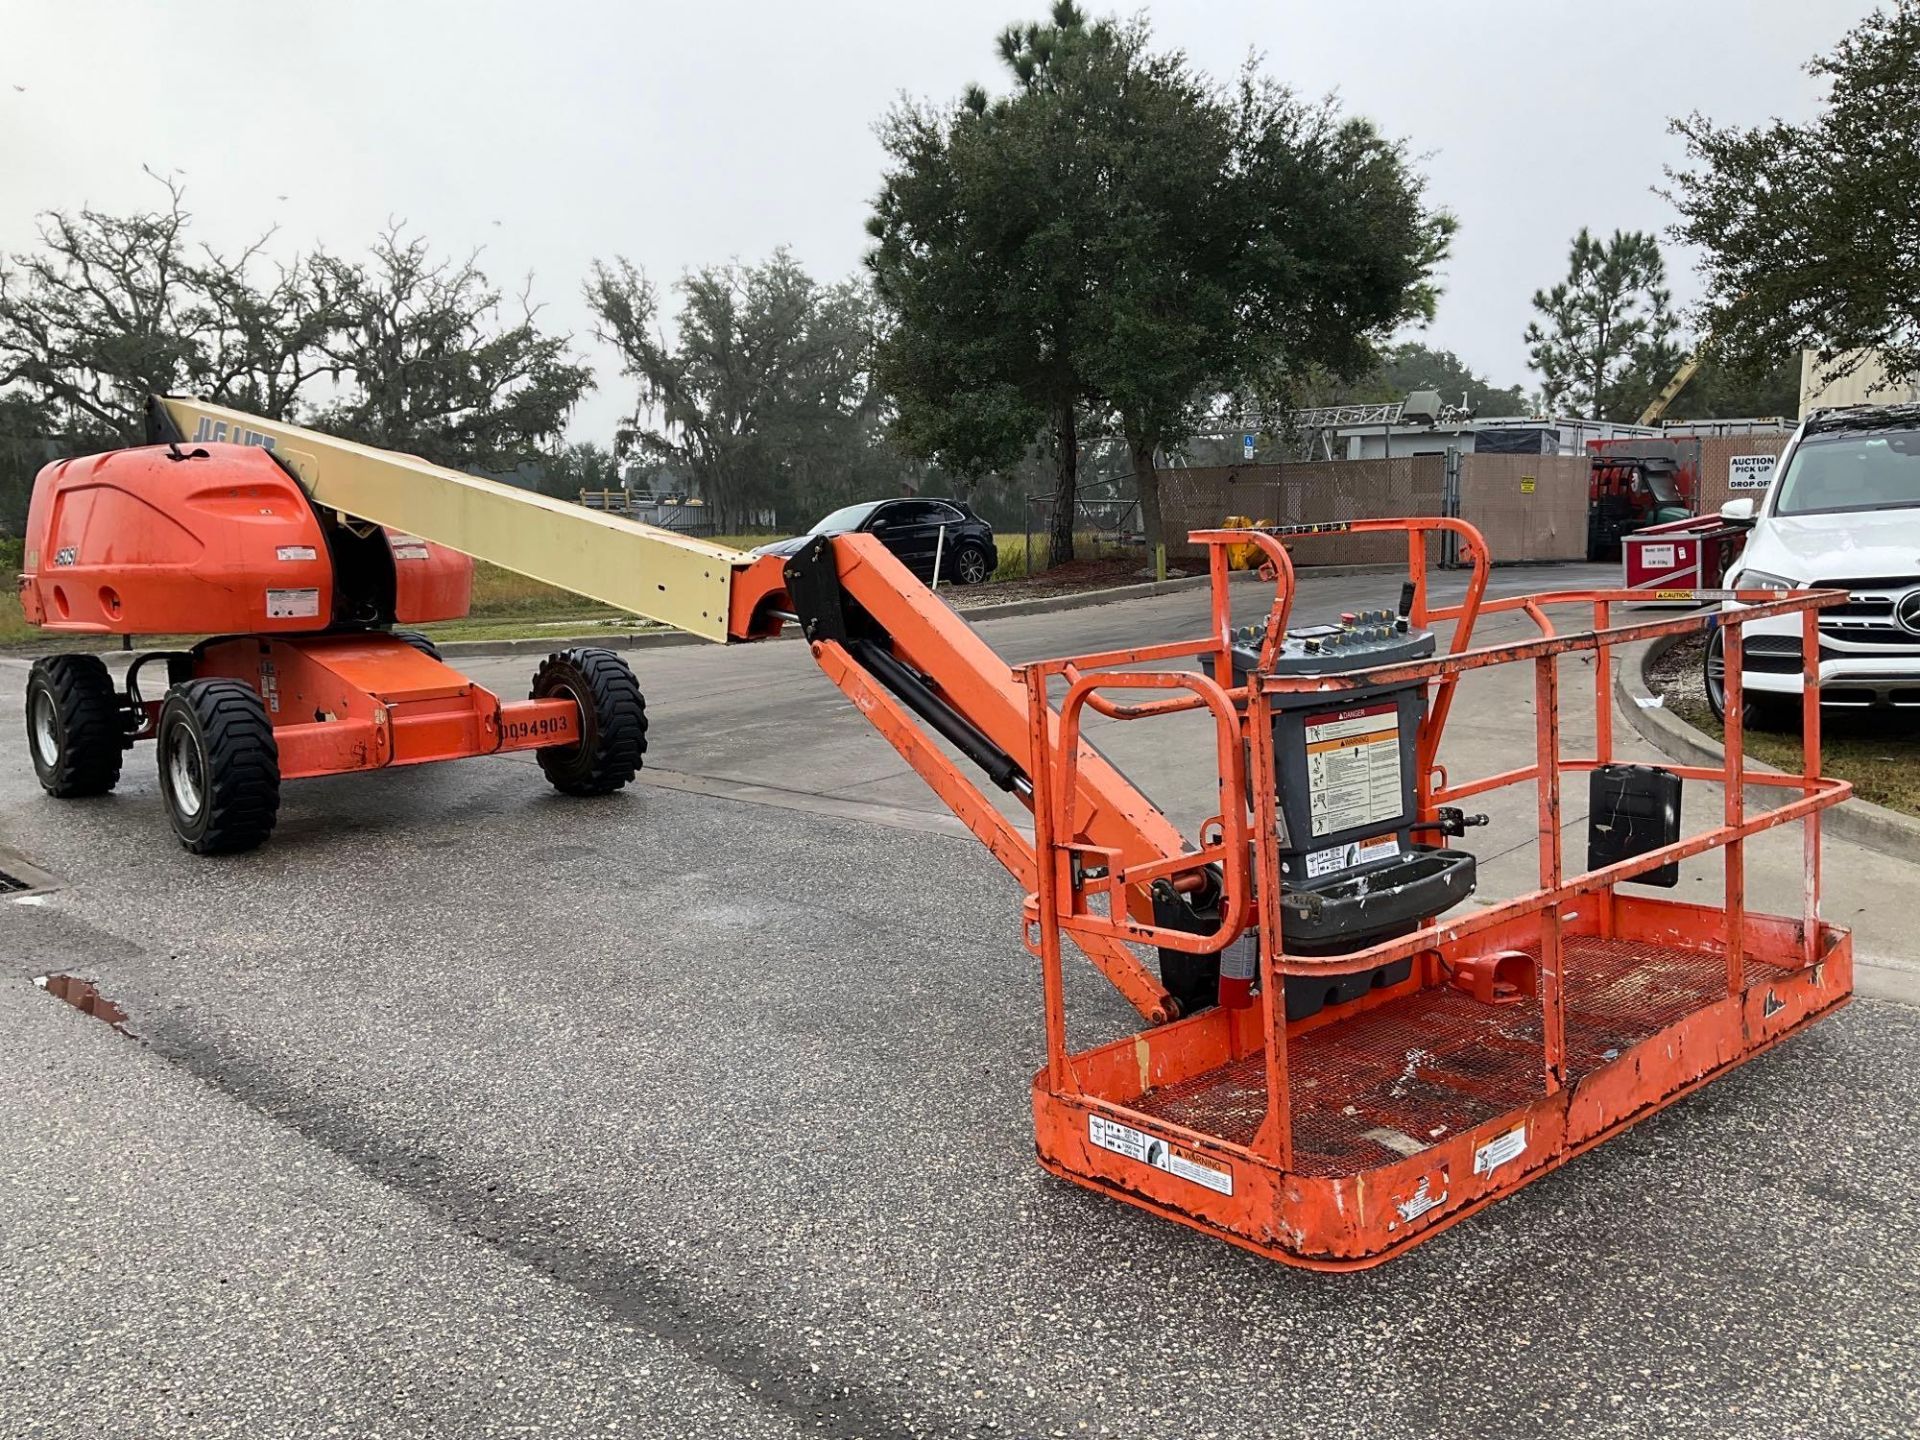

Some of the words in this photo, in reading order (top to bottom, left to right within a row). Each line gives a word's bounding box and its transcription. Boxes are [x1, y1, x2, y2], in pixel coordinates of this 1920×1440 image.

[1732, 457, 1774, 465] AUCTION
[1343, 709, 1365, 720] DANGER
[1345, 735, 1370, 748] WARNING
[1184, 1149, 1222, 1171] WARNING
